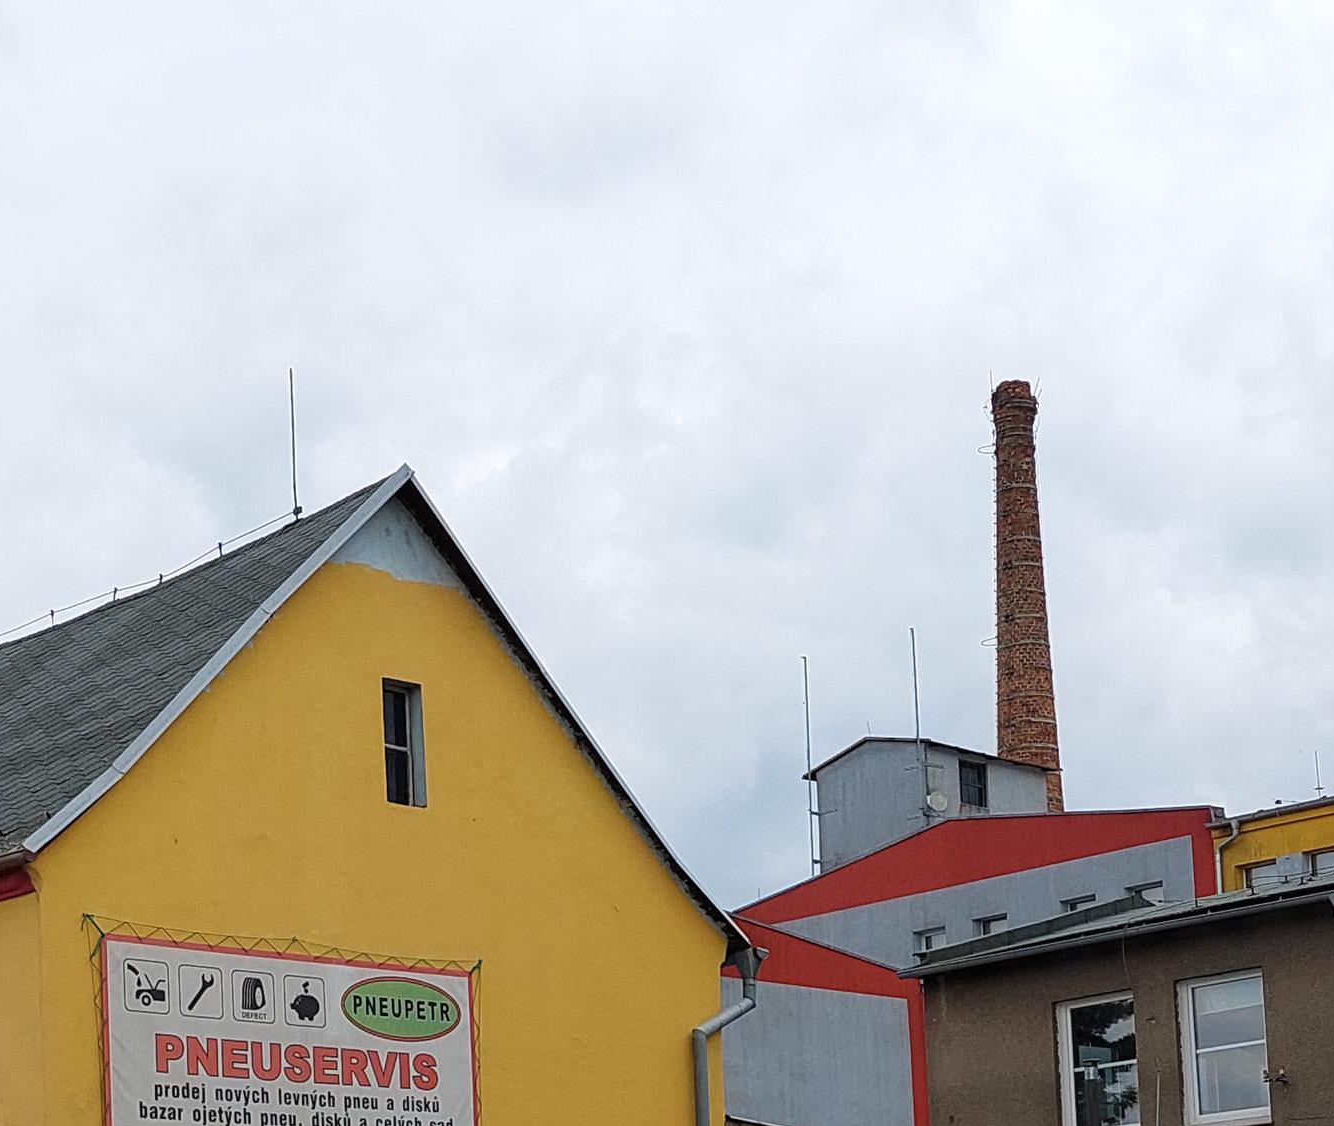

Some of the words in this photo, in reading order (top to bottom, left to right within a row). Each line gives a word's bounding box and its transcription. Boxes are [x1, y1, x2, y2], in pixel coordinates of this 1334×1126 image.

[241, 1011, 268, 1021] DEFECT
[352, 995, 451, 1022] PNEUPETR
[154, 1033, 439, 1091] PNEUSERVIS
[154, 1083, 206, 1101] prodej
[215, 1086, 270, 1107] nových
[278, 1088, 336, 1110] levných
[343, 1094, 378, 1112] pneu
[386, 1099, 395, 1111] a
[402, 1095, 440, 1114] disků
[139, 1101, 184, 1121] bazar
[192, 1105, 252, 1126] ojetých
